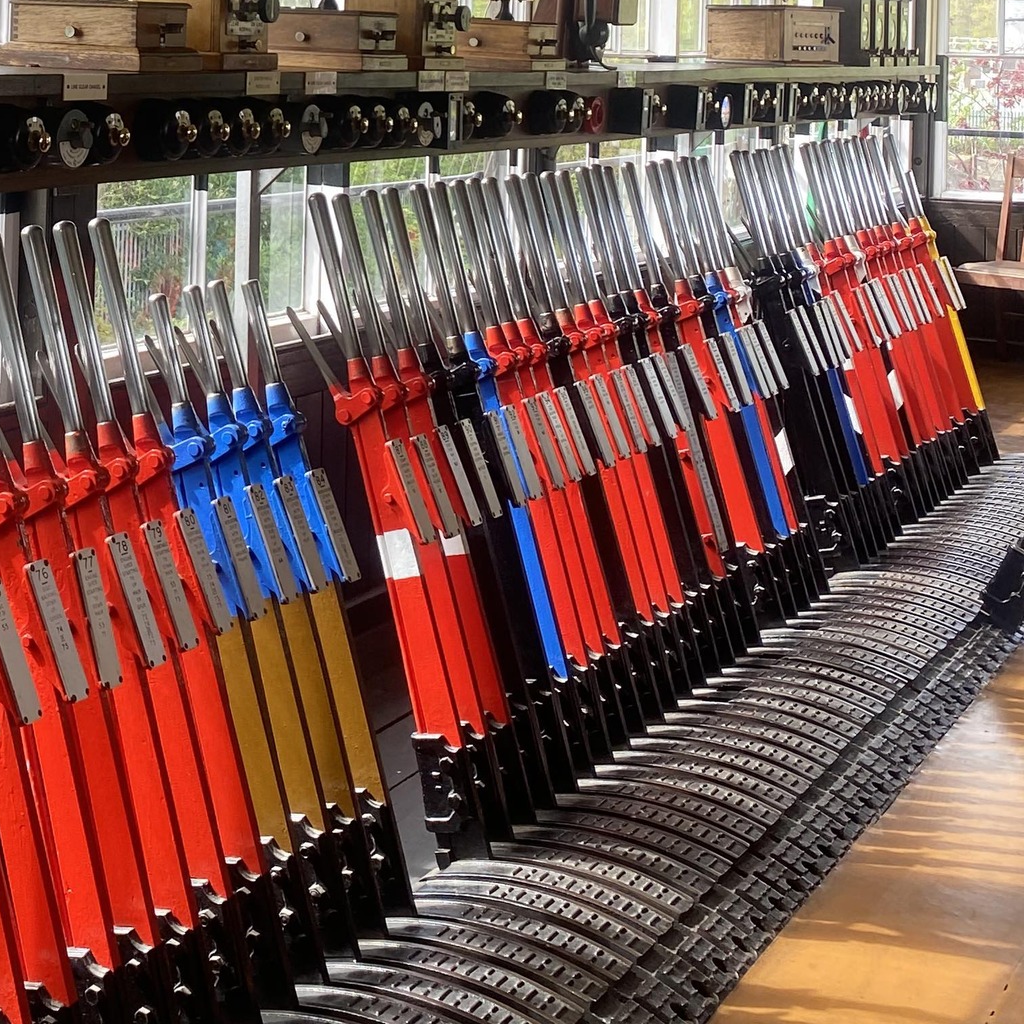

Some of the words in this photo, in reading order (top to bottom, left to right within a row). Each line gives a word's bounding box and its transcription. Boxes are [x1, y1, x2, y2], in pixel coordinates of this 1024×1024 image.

[184, 514, 196, 526] 80
[151, 526, 162, 539] 79
[116, 540, 128, 554] 78
[83, 556, 93, 569] 77
[35, 568, 49, 582] 76
